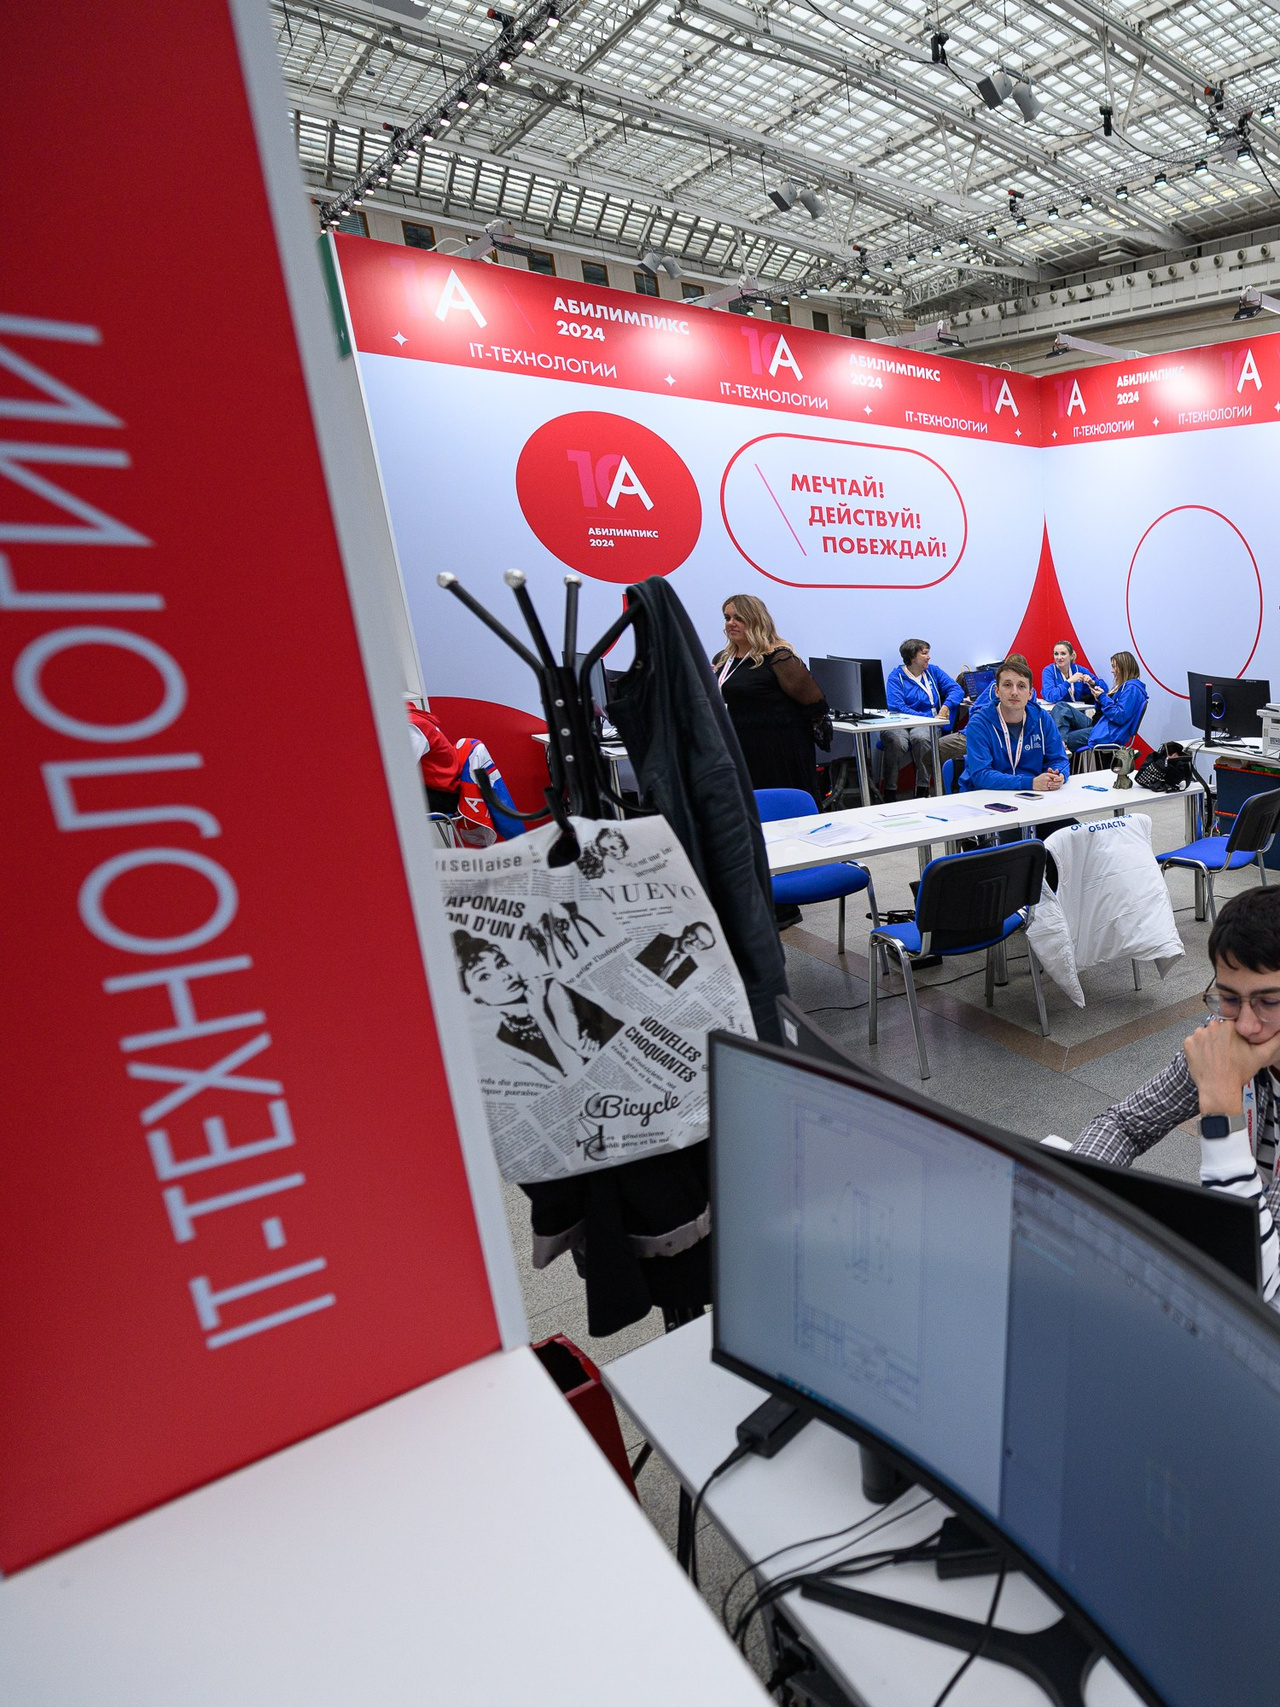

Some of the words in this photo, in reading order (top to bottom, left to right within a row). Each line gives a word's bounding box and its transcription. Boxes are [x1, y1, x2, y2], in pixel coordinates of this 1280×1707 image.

[553, 297, 690, 335] АБИЛИМПИКС
[556, 320, 606, 342] 2024
[469, 342, 618, 379] IT-ТЕХНОЛОГИИ
[848, 353, 941, 382] АБИЛИМПИКС
[851, 372, 884, 390] 2024
[1116, 366, 1185, 388] АБИЛИМПИКС
[720, 381, 829, 410] IT-ТЕХНОЛОГИИ
[1117, 391, 1140, 406] 2024
[905, 410, 989, 434] IT-ТЕХНОЛОГИИ
[1073, 420, 1135, 438] IT-ТЕХНОЛОГИИ
[791, 473, 885, 499] МЕЧТАЙ!
[809, 503, 922, 530] ДЕЙСТВУЙ!
[588, 526, 659, 539] АБИЛИМПИКС
[589, 538, 615, 548] 2024
[822, 536, 948, 560] ПОБЕЖДАЙ!
[1088, 820, 1126, 833] ОБЛАСТЬ
[443, 895, 526, 919] APONAIS
[625, 1026, 697, 1083] CHOQUANTES
[598, 1092, 682, 1127] Bicycle
